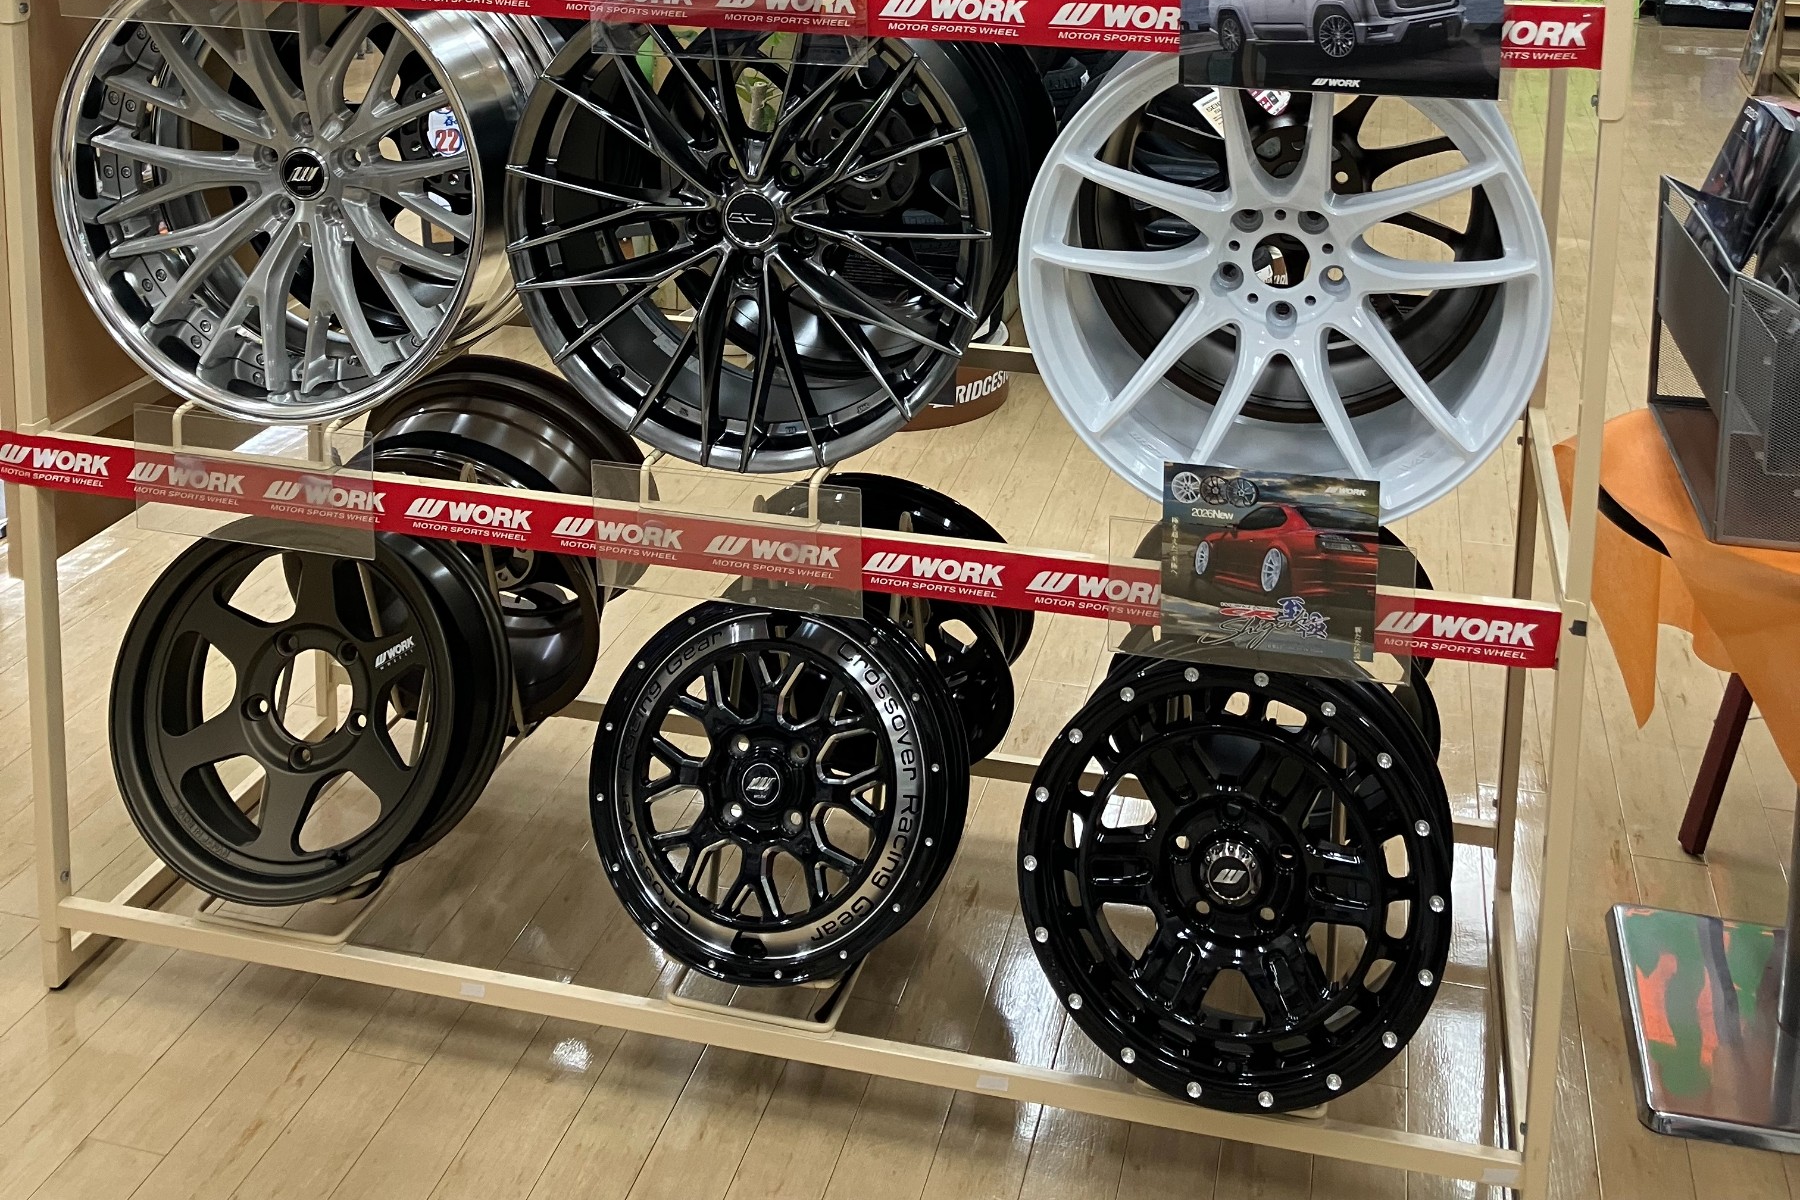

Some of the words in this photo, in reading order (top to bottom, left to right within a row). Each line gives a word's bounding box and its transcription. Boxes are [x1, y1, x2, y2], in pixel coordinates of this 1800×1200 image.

[566, 3, 604, 12] MOTOR
[606, 6, 649, 15] SPORTS
[651, 9, 688, 18] WHEEL
[724, 13, 764, 22] MOTOR
[766, 15, 810, 25] SPORTS
[812, 18, 851, 27] WHEEL
[1102, 4, 1181, 30] WOR
[888, 22, 929, 31] MOTOR
[931, 24, 977, 34] SPORTS
[979, 27, 1020, 37] WHEEL
[1058, 31, 1101, 41] MOTOR
[1103, 33, 1152, 43] SPORTS
[1154, 36, 1181, 45] WHE
[1532, 52, 1578, 60] WHEEL
[1327, 78, 1361, 88] WORK
[436, 129, 459, 152] 22
[955, 370, 1009, 404] RIDGES
[32, 448, 110, 476] WORK
[0, 466, 31, 477] MOTOR
[32, 471, 70, 483] SPORTS
[72, 477, 104, 488] WHEEL
[167, 465, 246, 494] WORK
[134, 486, 167, 496] MOTOR
[168, 490, 206, 501] SPORTS
[207, 496, 240, 506] WHEEL
[304, 485, 387, 513] WORK
[1340, 486, 1367, 497] WORK
[271, 503, 305, 514] MOTOR
[307, 508, 345, 519] SPORTS
[346, 513, 381, 523] WHEEL
[448, 501, 533, 530] WORK
[413, 521, 448, 531] MOTOR
[450, 525, 490, 537] SPORTS
[491, 531, 527, 542] WHEEL
[596, 520, 684, 550] WORK
[560, 540, 597, 550] MOTOR
[599, 545, 640, 556] SPORTS
[641, 550, 678, 561] WHEEL
[751, 538, 842, 568] WORK
[712, 559, 750, 569] MOTOR
[752, 563, 795, 575] SPORTS
[796, 568, 834, 579] WHEEL
[910, 555, 1006, 587] WORK
[870, 576, 909, 587] MOTOR
[911, 581, 956, 593] SPORTS
[958, 587, 998, 598] WHEEL
[1034, 596, 1076, 607] MOTOR
[1078, 601, 1125, 613] SPORTS
[1126, 607, 1161, 619] WHEE
[1432, 614, 1539, 648] WORK
[386, 635, 416, 660] WORK
[665, 628, 724, 675] Gear
[1384, 637, 1428, 649] MOTOR
[1431, 642, 1481, 655] SPORTS
[1483, 648, 1528, 660] WHEEL
[836, 640, 918, 782] Crossover
[619, 681, 662, 773] Racing
[871, 793, 922, 891] Racing
[619, 785, 691, 927] Crossover
[810, 893, 876, 943] Gear
